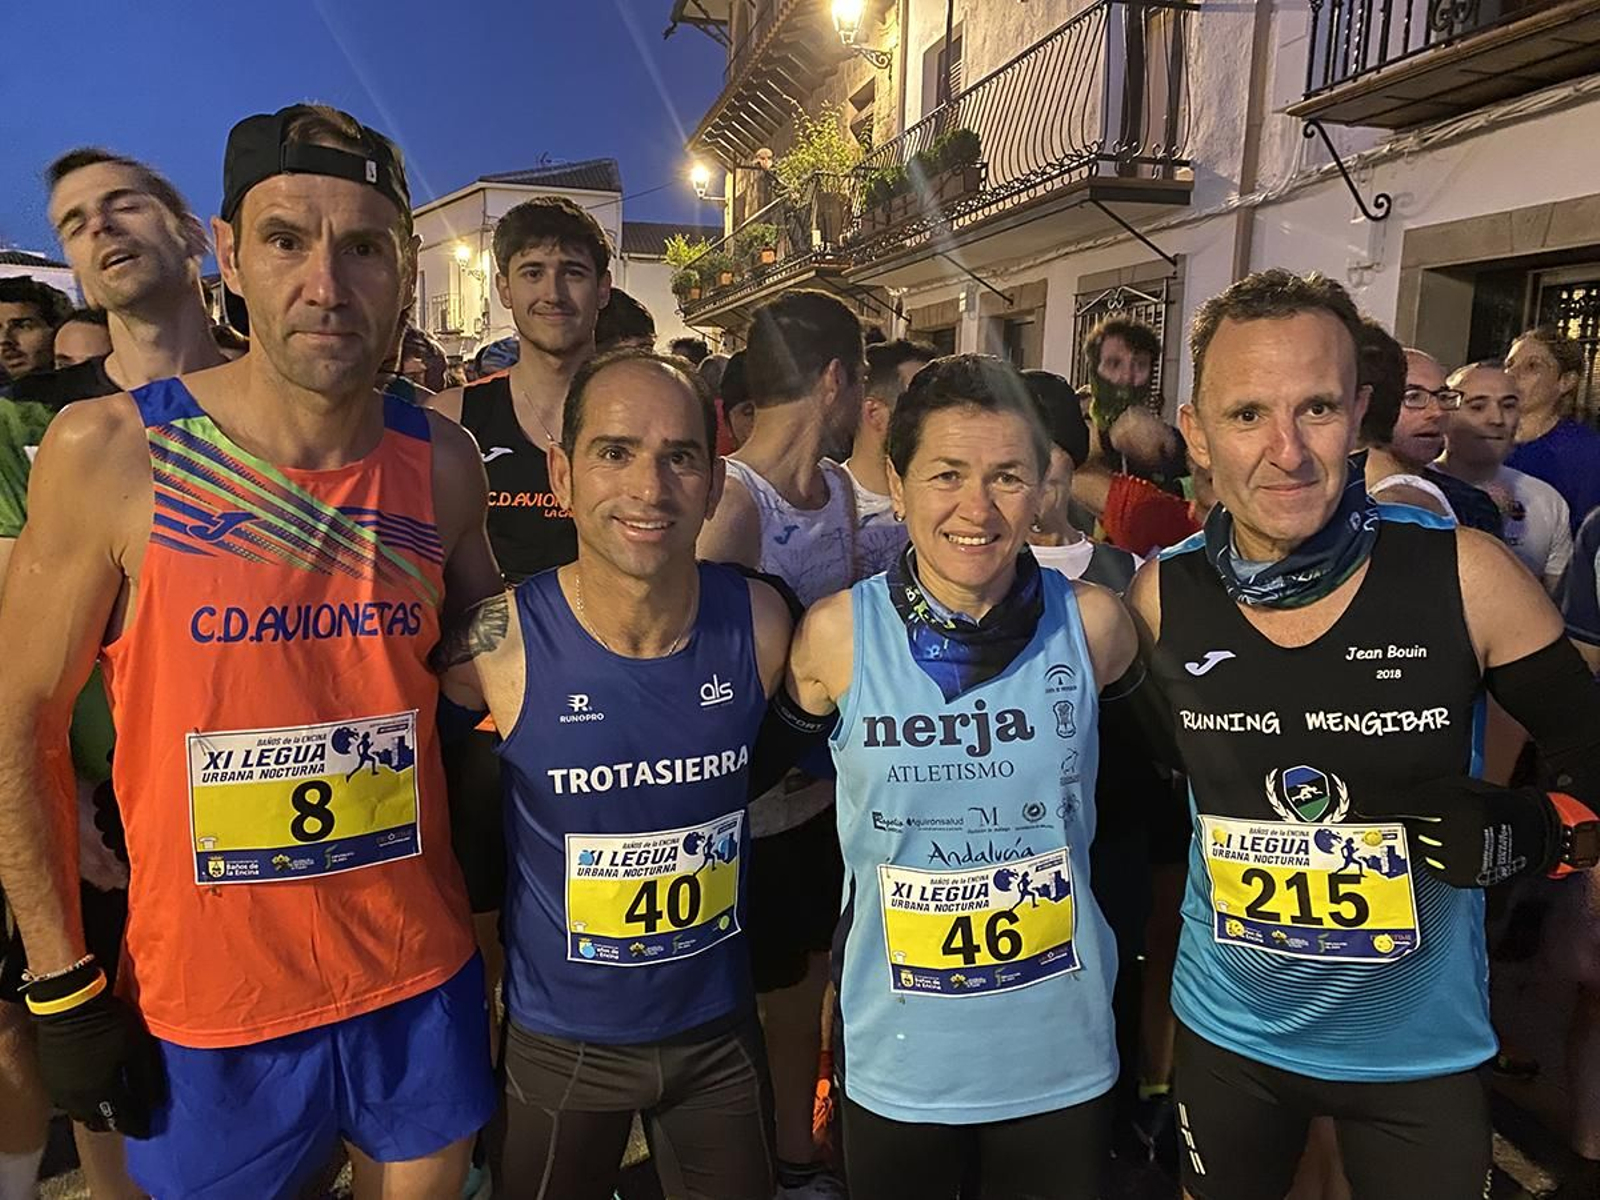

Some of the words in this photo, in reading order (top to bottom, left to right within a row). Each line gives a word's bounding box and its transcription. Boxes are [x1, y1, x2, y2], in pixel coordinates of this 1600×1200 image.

[487, 491, 559, 507] C.D.AVIO
[190, 602, 422, 644] C.D.AVIONETAS
[1345, 646, 1383, 661] Jean
[1387, 644, 1427, 658] Bouin
[1376, 668, 1402, 679] 2018
[559, 712, 605, 723] RUNOPRO
[863, 698, 1035, 758] nerja
[1180, 709, 1281, 735] RUNNING
[1305, 707, 1450, 737] MENGIBAR
[202, 751, 234, 770] XI
[241, 743, 327, 769] LEGUA
[202, 770, 254, 783] URBANA
[259, 763, 325, 780] NOCTURNA
[547, 744, 749, 795] TROTASIERRA
[886, 760, 1015, 783] ATLETISMO
[291, 780, 335, 843] 8
[609, 846, 678, 867] LEGUA
[928, 837, 1036, 867] Andalucía
[1240, 835, 1310, 856] LEGUA
[1212, 847, 1250, 862] URBANA
[1253, 854, 1310, 867] NOCTURNA
[577, 867, 619, 878] URBANA
[622, 863, 677, 878] NOCTURNA
[891, 881, 913, 899] XI
[920, 882, 989, 902] LEGUA
[1241, 867, 1370, 929] 215
[624, 875, 701, 934] 40
[891, 898, 930, 912] URBANA
[934, 899, 990, 912] NOCTURNA
[941, 910, 1023, 966] 46
